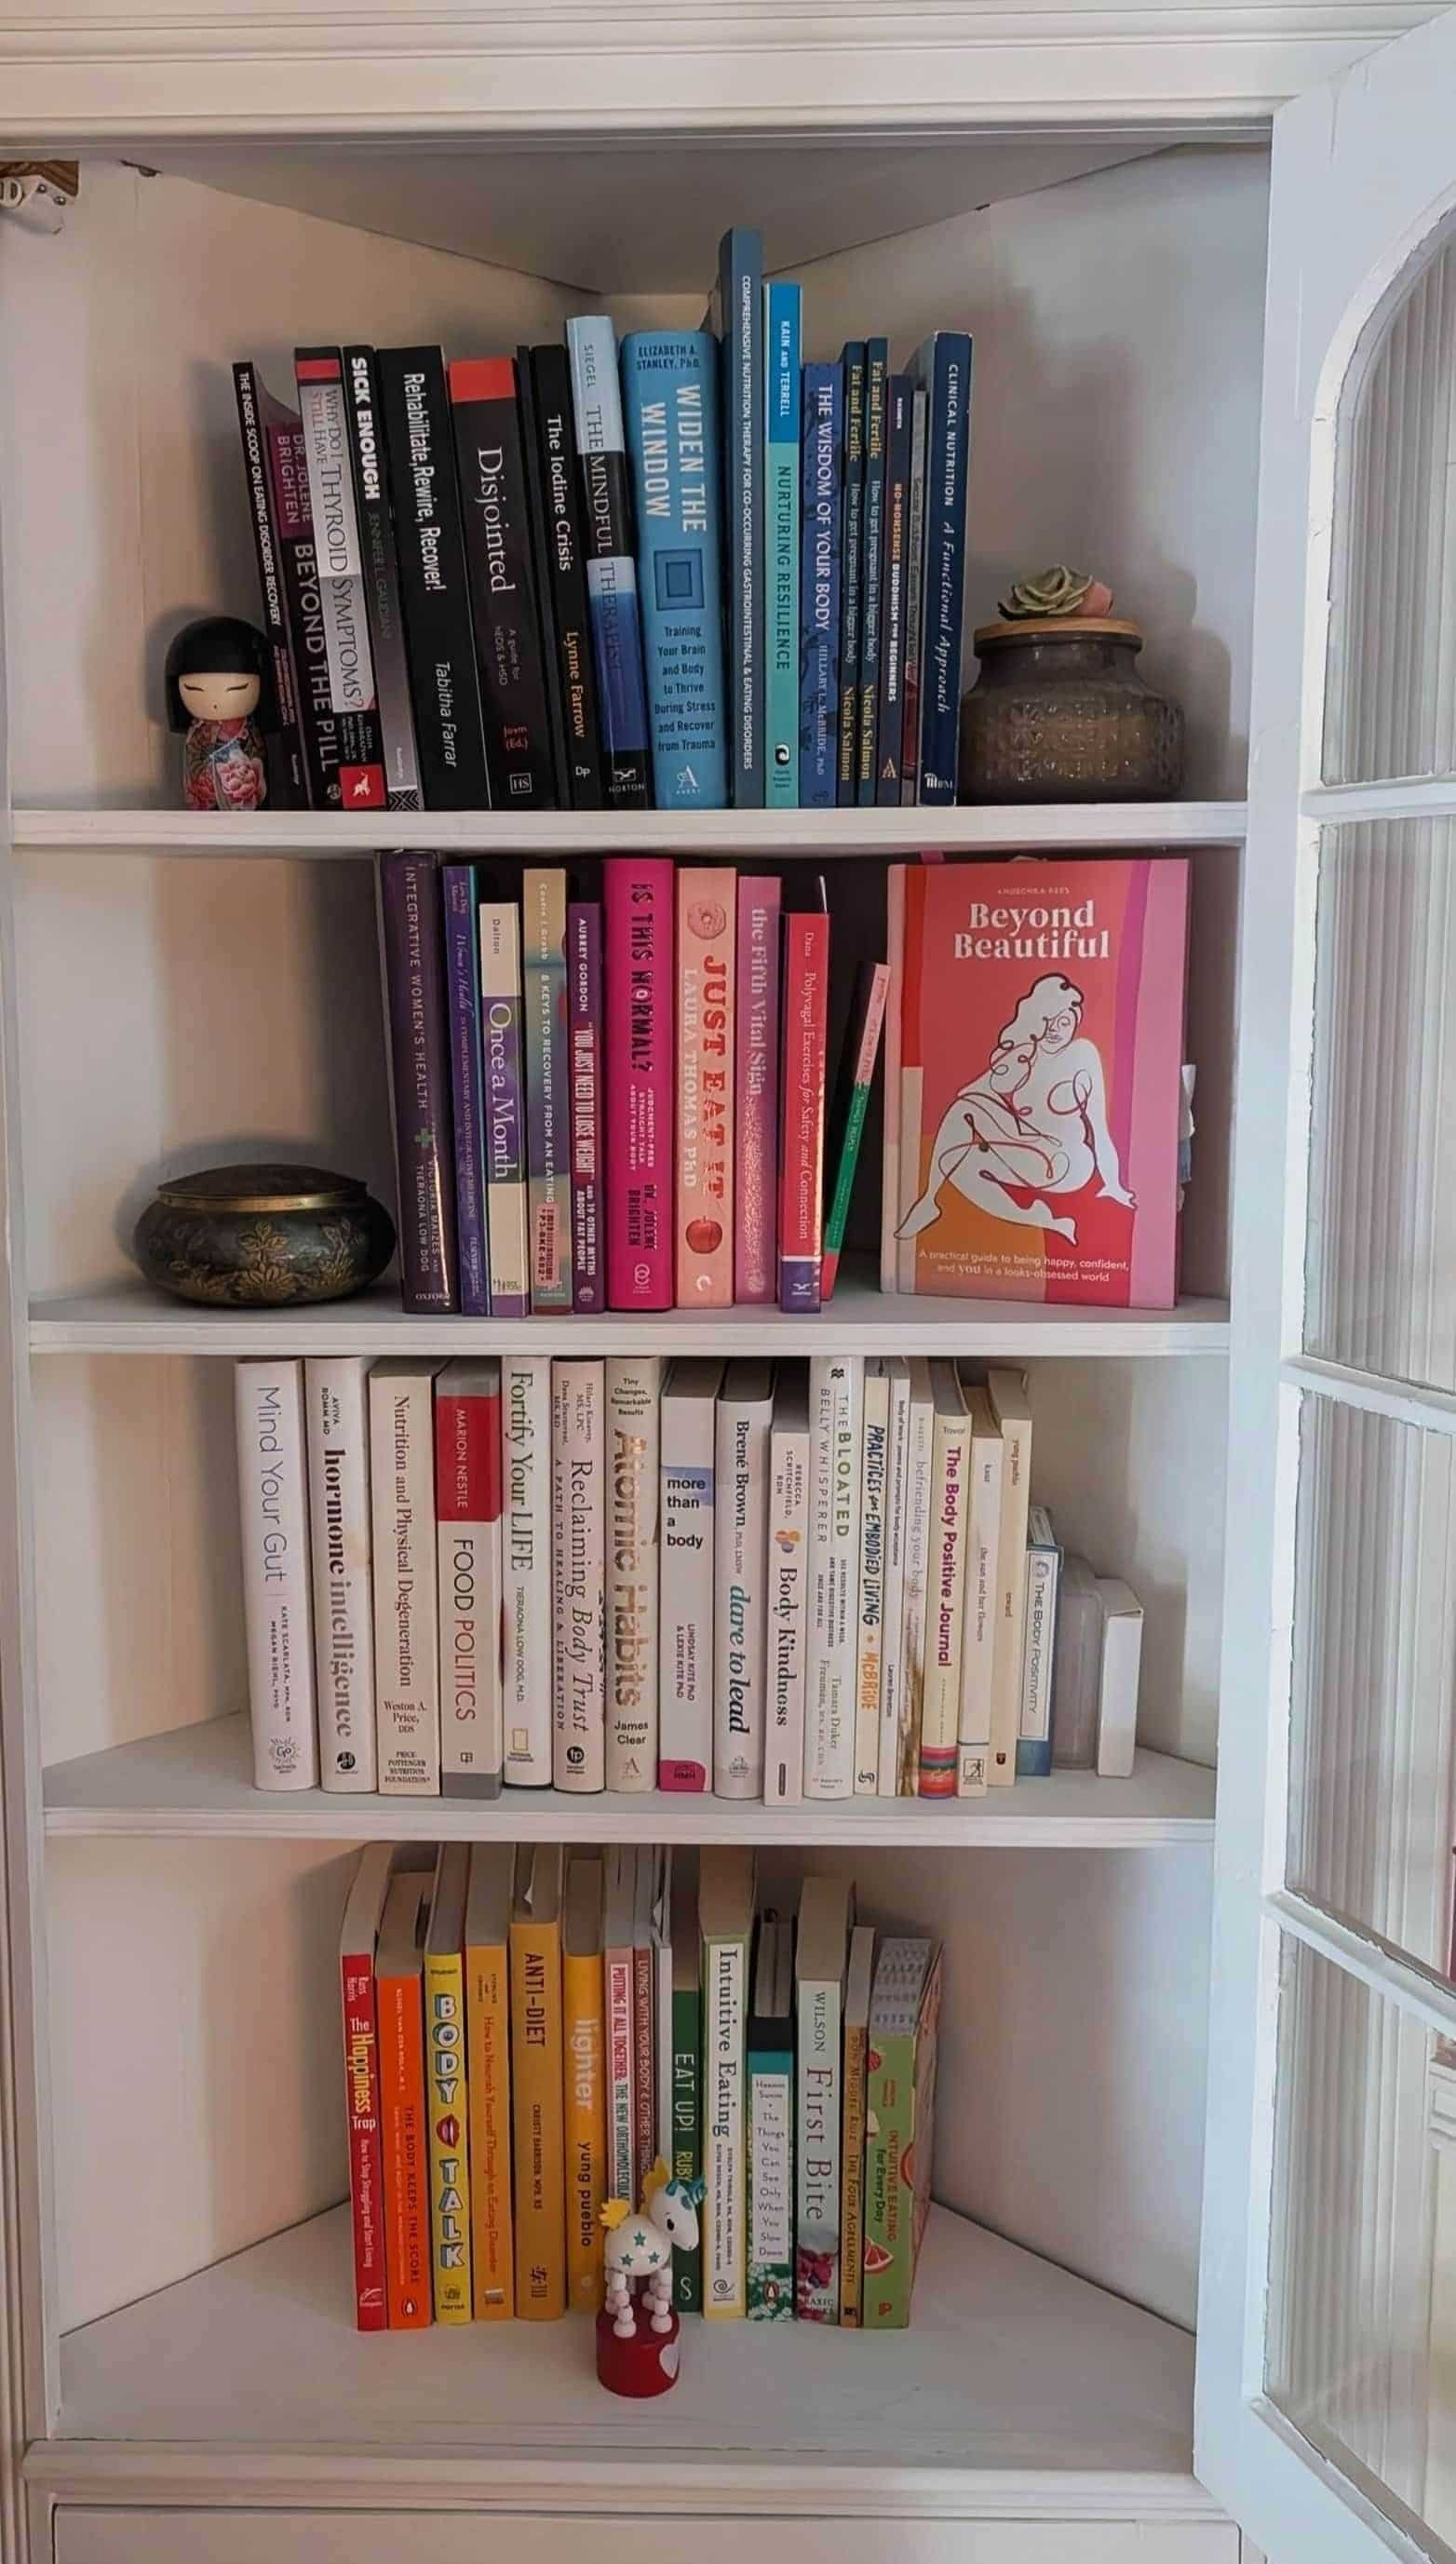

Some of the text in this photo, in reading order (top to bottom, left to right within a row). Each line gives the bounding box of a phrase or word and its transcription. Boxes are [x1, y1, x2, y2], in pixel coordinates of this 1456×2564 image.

[584, 344, 596, 387] SIEGEL
[780, 321, 789, 347] KAIN
[352, 358, 379, 499] SICK ENOUGH
[780, 371, 789, 417] TERRELL
[240, 373, 280, 626] THE INSIDE SCOOP ON EATING DISORDER RECOVERY
[547, 414, 573, 571] The Iodine Crisis
[586, 404, 612, 553] THE MINDFUL
[641, 401, 670, 519] WINDOW
[677, 385, 708, 533] WIDEN THE
[816, 385, 831, 630] THE WISDOM OF YOUR BODY
[418, 527, 445, 590] Recover!
[473, 447, 514, 592] Disjointed
[742, 275, 752, 768] COMPREHENSIVE NUTRITION THERAPY FOR CO-OCCURRING GASTROINTESTINAL EATING DISORDERS
[776, 466, 789, 670] NURTURING RESILIENCE
[934, 364, 957, 713] CLINICAL NUTRITION A Functional Approach
[294, 544, 339, 772] BEYOND THE PILL
[563, 631, 586, 737] Lynne Farrow
[657, 642, 706, 657] Your Brain
[663, 662, 705, 678] and Body
[664, 625, 702, 639] Training
[435, 662, 458, 767] Tabitha Farrar
[665, 681, 706, 695] to Thrive
[954, 931, 1109, 959] Beautiful
[970, 899, 1095, 937] Beyond
[405, 865, 427, 1108] INTEGRATIVE WOMEN'S HEALTH
[579, 963, 587, 1010] GORDON
[631, 883, 652, 1071] IS THIS NORMAL?
[746, 909, 767, 1094] the Fifth Vital Sign
[489, 1003, 516, 1179] Once a Month
[574, 1049, 594, 1136] JUST NEED TO LOSE
[703, 955, 726, 1197] JUST EAT IT
[799, 972, 816, 1238] Polyvagal Exercises for Safety and Connection
[257, 1386, 287, 1580] Mind Your Gut
[455, 1409, 467, 1509] MARION NESTLE
[506, 1372, 533, 1570] Fortify Your LIFE
[667, 1478, 707, 1490] more
[667, 1495, 700, 1509] than
[735, 1421, 749, 1526] Brené Brown
[836, 1395, 850, 1536] THE BLOATED
[941, 1483, 958, 1525] Body
[946, 1446, 960, 1477] The
[393, 1396, 413, 1686] Nutrition and Physical Degeneration
[614, 1429, 647, 1706] Atomic Habits
[667, 1518, 676, 1528] a
[667, 1532, 704, 1549] body
[941, 1531, 956, 1596] Positive
[324, 1449, 356, 1736] hormone intelligence
[453, 1539, 474, 1721] FOOD POLITICS
[564, 1459, 592, 1732] Reclaiming Body Trust
[938, 1601, 953, 1665] Journal
[729, 1585, 750, 1734] dare to lead
[774, 1567, 798, 1725] Body Kindness
[614, 1720, 650, 1731] James
[616, 1734, 646, 1745] Clear
[525, 1953, 546, 2046] ANTI-DIET
[613, 1966, 627, 2122] PUTTING IT ALL TOGETHER: THE NEW
[713, 1949, 737, 2139] Intuitive Eating
[814, 1990, 825, 2052] WILSON
[346, 2032, 373, 2113] Happiness
[572, 2018, 599, 2109] lighter
[675, 2053, 694, 2130] EAT UP!
[432, 1993, 465, 2268] BODY TALK
[676, 2152, 693, 2182] RUBY
[806, 2067, 832, 2220] First Bite
[577, 2141, 594, 2246] yung pueblo
